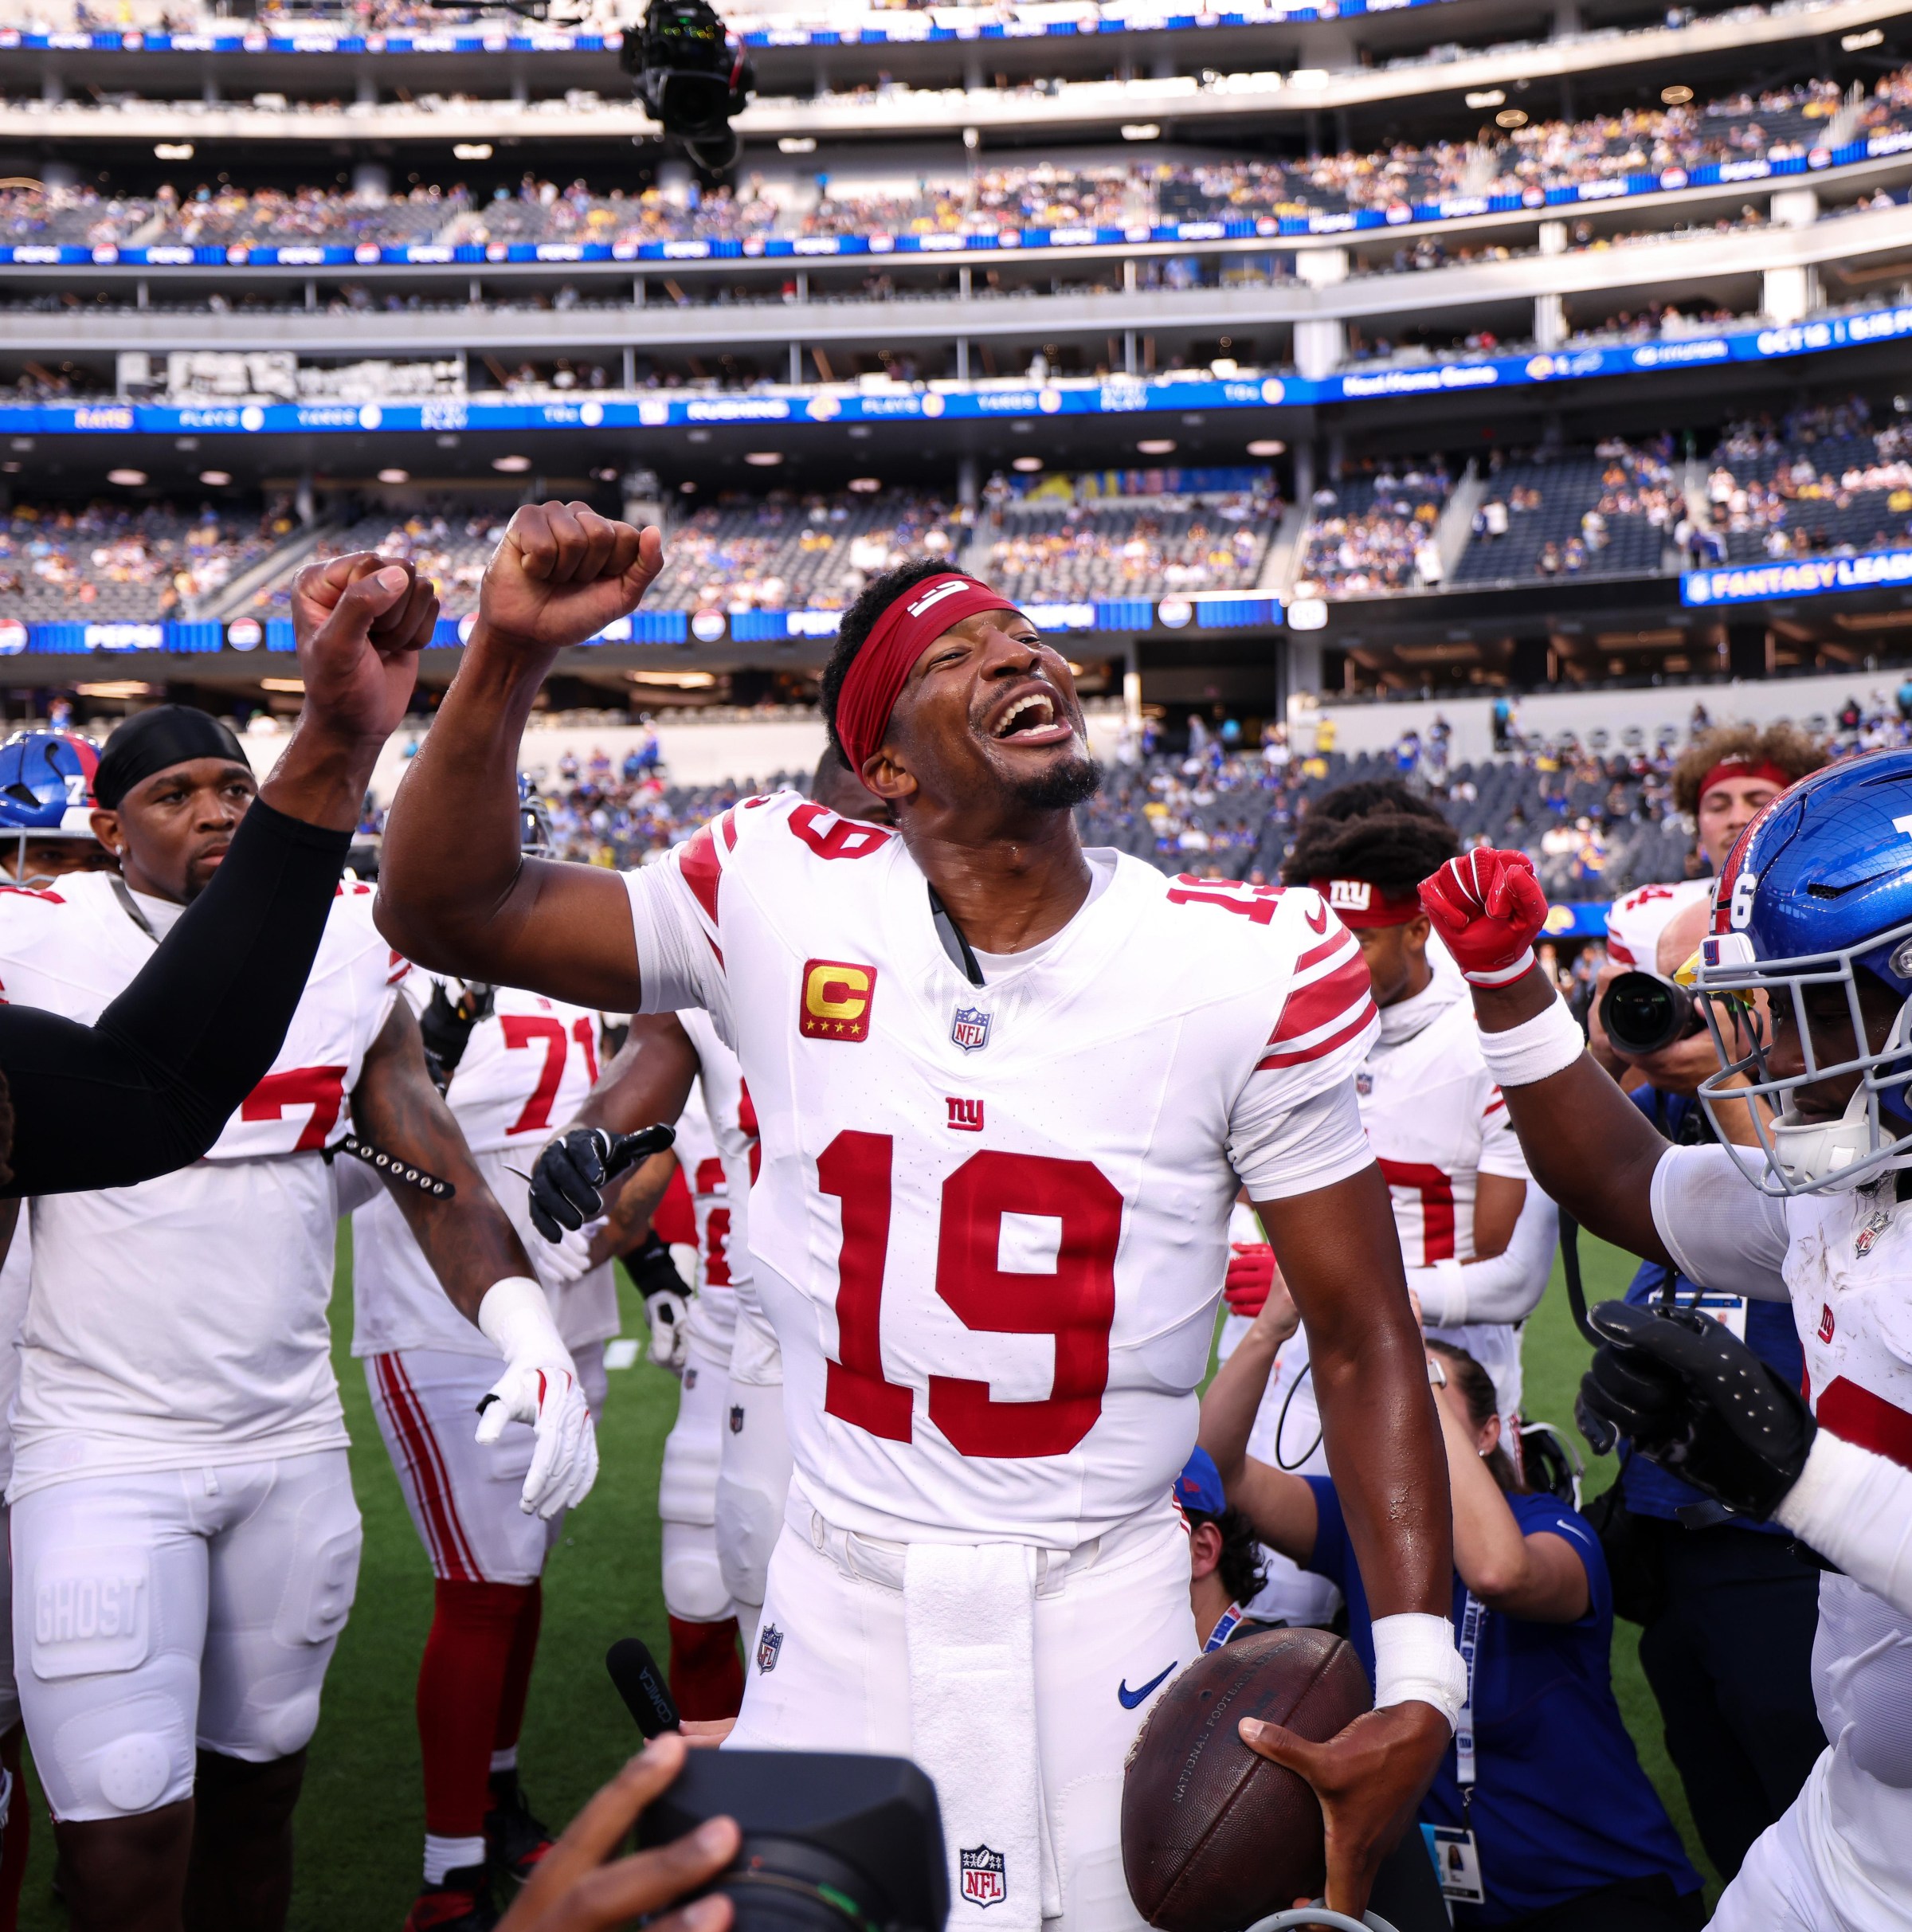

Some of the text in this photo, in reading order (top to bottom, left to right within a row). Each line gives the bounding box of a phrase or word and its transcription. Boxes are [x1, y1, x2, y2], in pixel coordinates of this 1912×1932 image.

[1712, 559, 1836, 598] FANTASY
[806, 966, 868, 1020] C
[955, 1023, 982, 1045] NFL
[500, 1015, 600, 1135] 71
[945, 1096, 985, 1131] ny
[816, 1130, 1124, 1459] 19
[36, 1575, 143, 1644] GHOST
[1173, 1733, 1209, 1804] NATIONAL
[966, 1871, 1001, 1899] NFL
